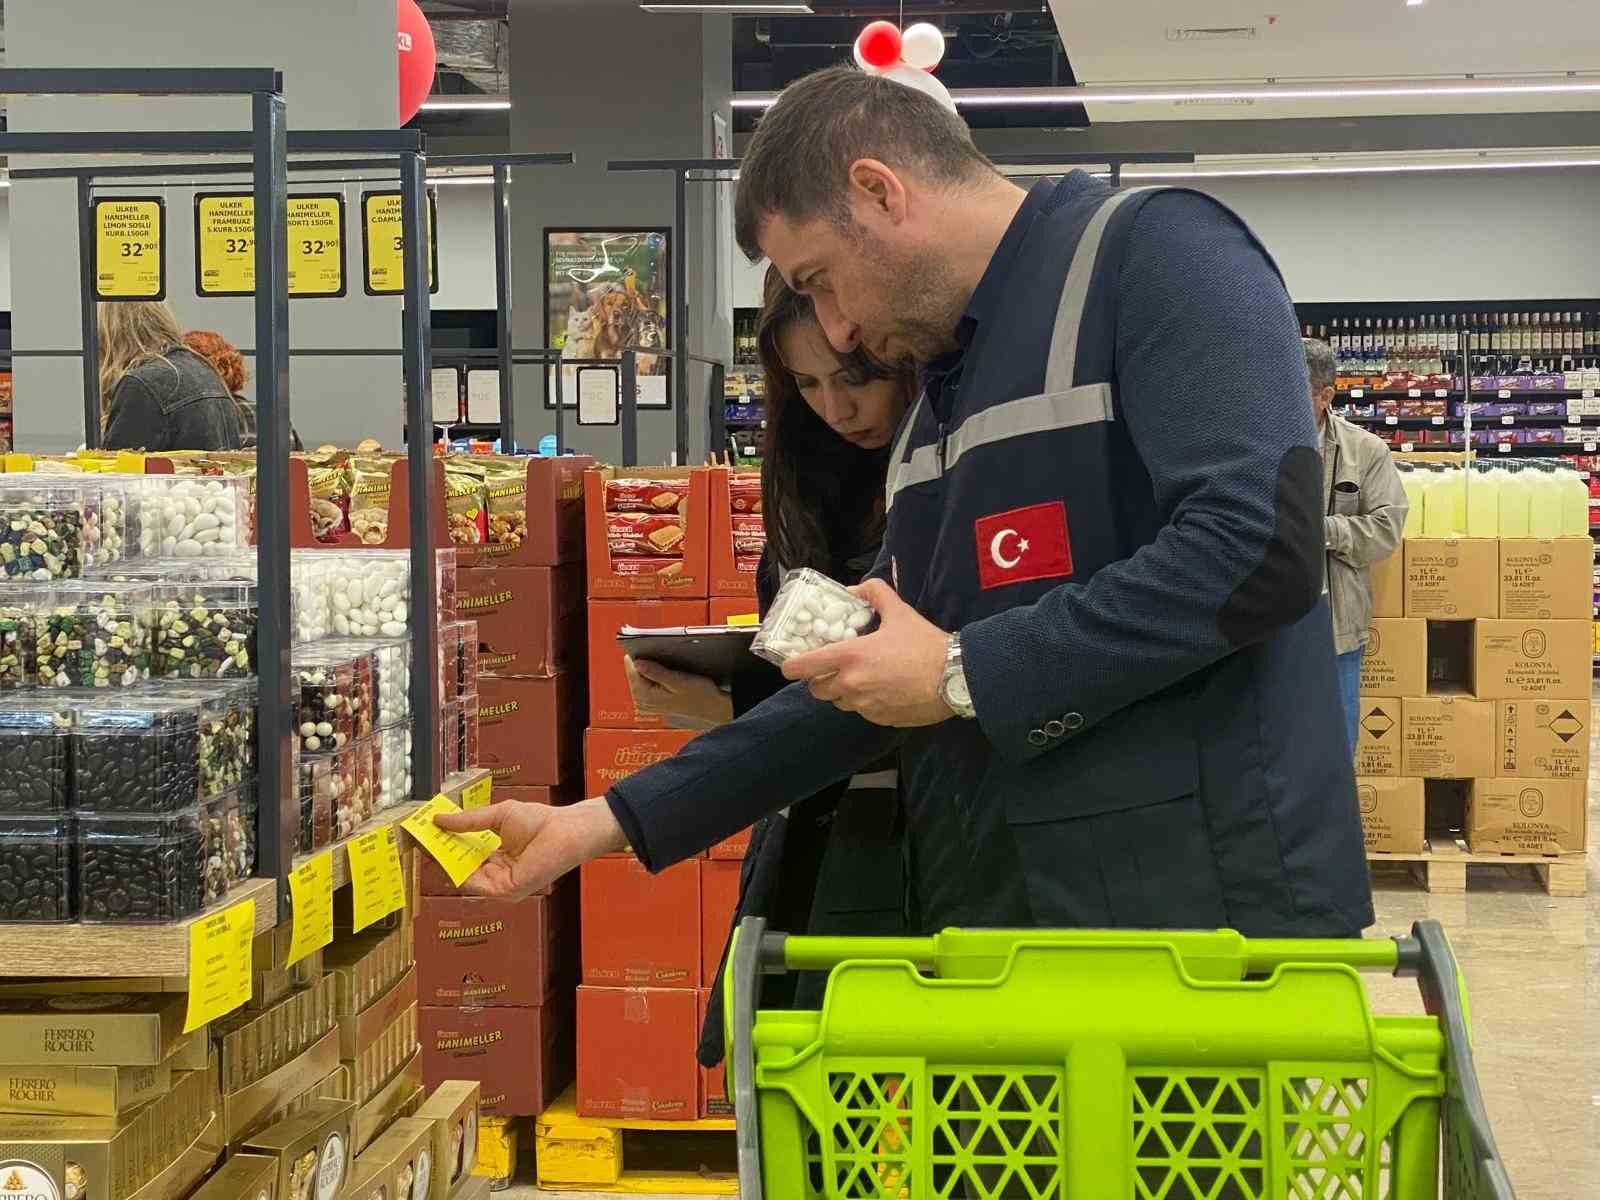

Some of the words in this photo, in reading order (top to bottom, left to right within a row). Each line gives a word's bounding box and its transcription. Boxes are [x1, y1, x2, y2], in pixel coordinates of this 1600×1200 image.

[456, 590, 513, 609] ANIMELLER
[438, 920, 504, 940] HANIMELLER
[44, 1028, 95, 1041] FERRERO
[437, 1030, 504, 1051] HANIMELLER
[44, 1040, 95, 1052] ROCHER
[9, 1078, 56, 1090] FERRERO
[9, 1089, 56, 1101] ROCHER
